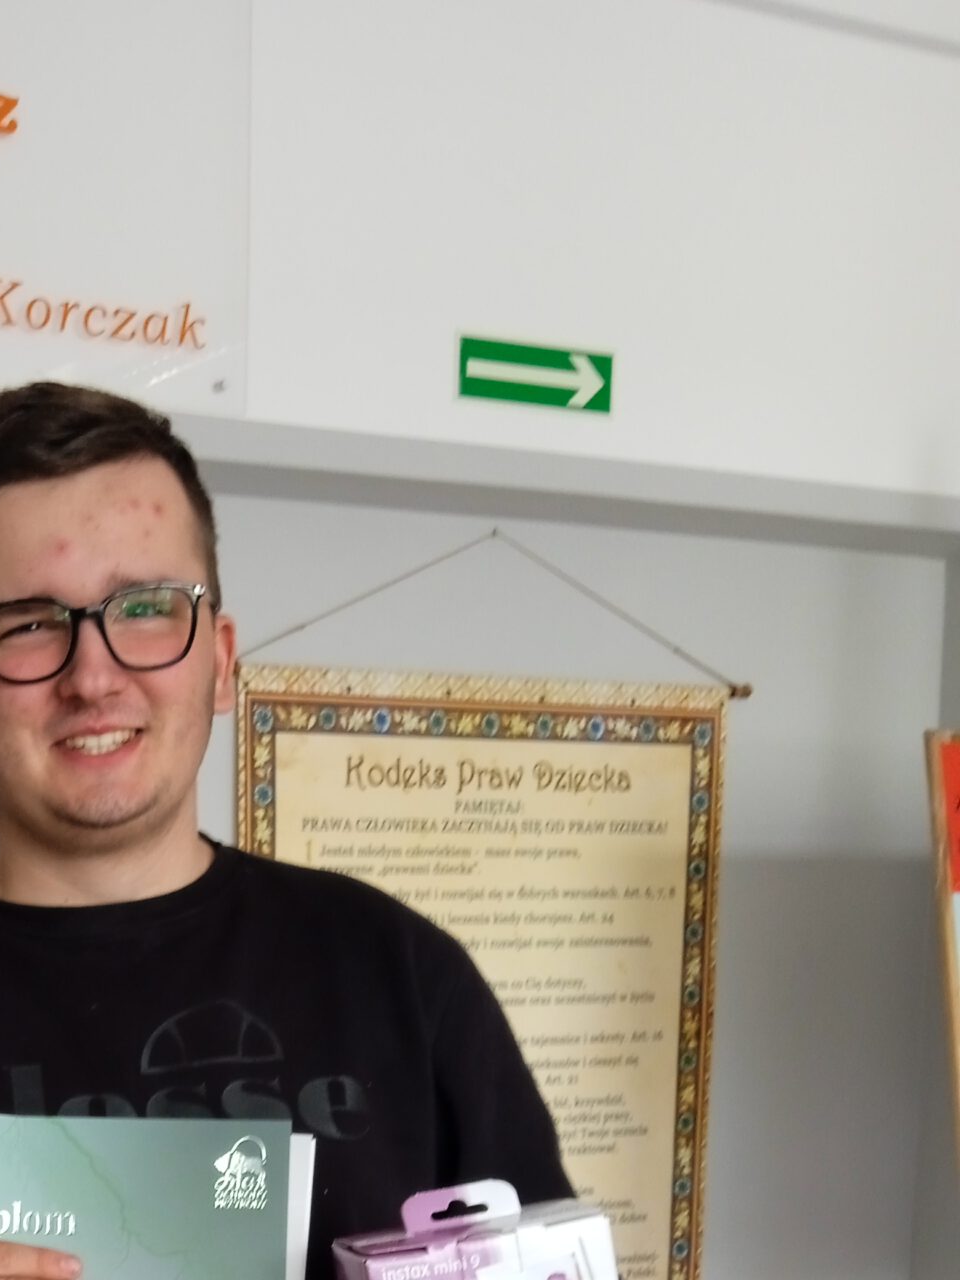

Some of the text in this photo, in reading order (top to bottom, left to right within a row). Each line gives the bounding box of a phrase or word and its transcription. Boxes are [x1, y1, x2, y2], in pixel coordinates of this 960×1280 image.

[344, 754, 632, 795] Kodeks Praw Dziecka
[302, 816, 351, 832] PRAWA
[434, 1255, 468, 1276] mini
[470, 1254, 481, 1269] 9
